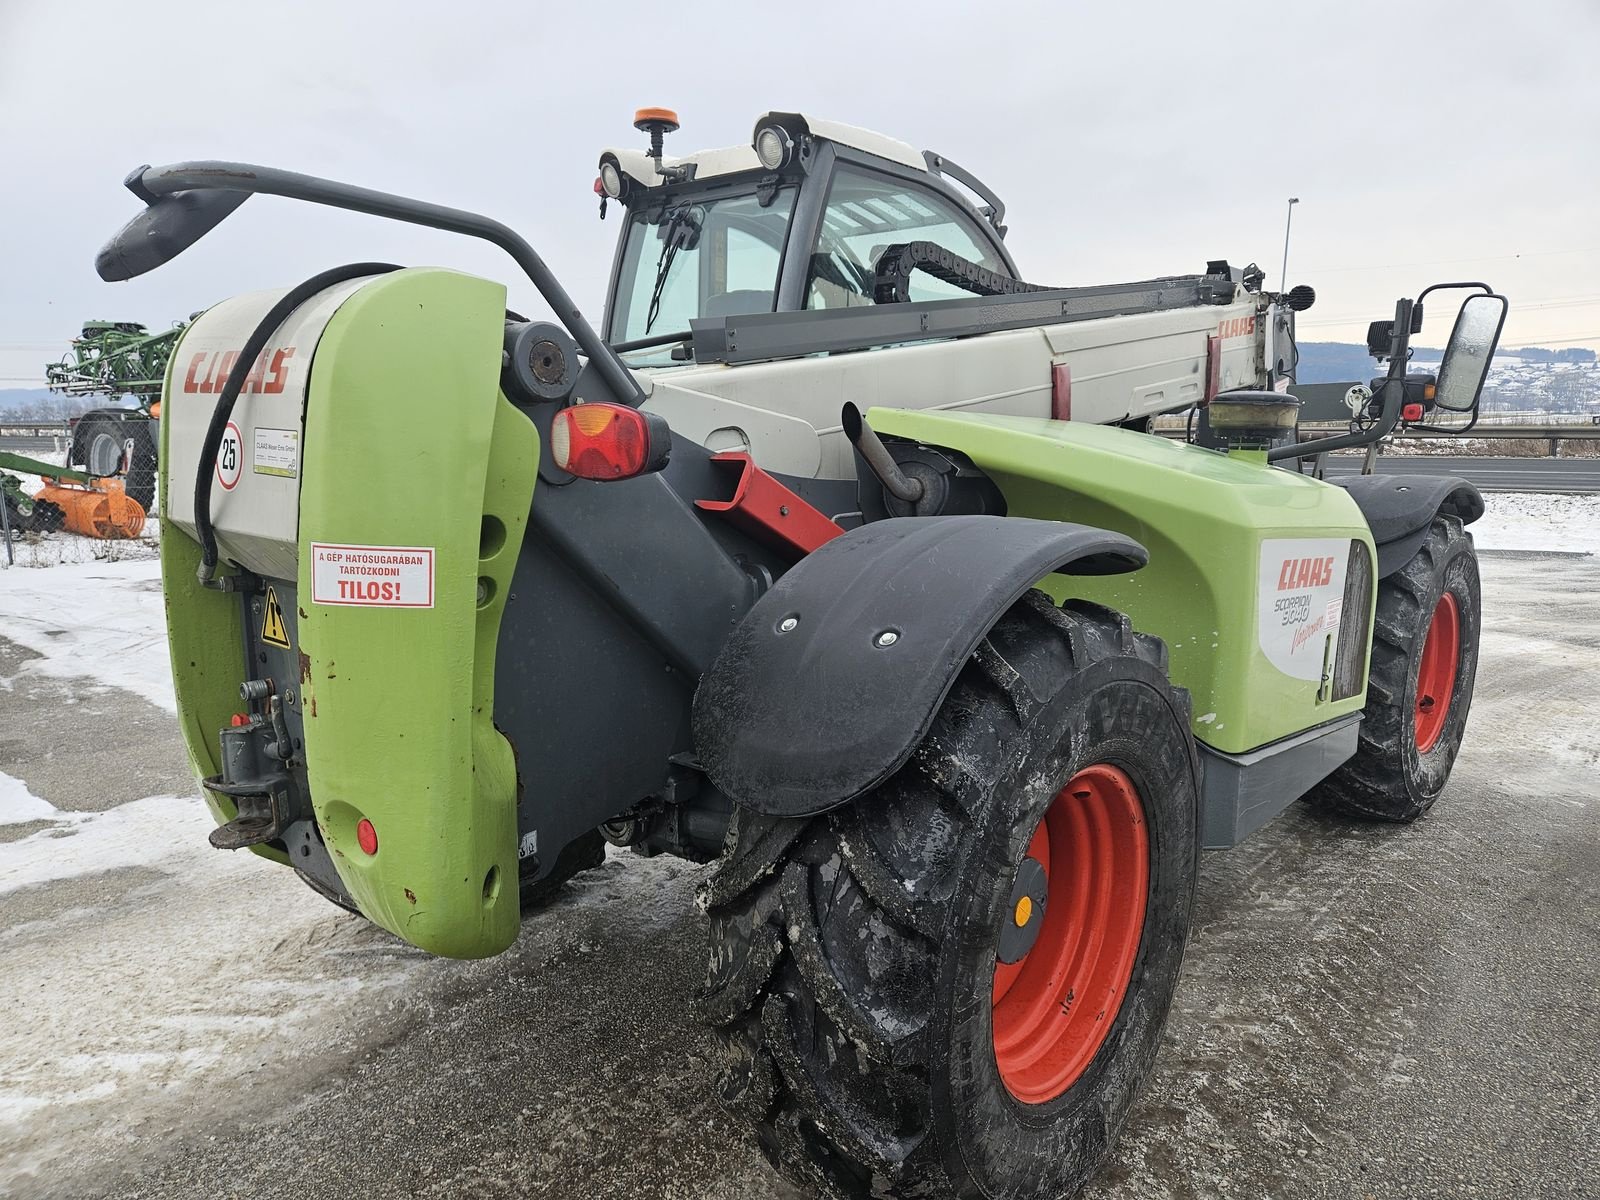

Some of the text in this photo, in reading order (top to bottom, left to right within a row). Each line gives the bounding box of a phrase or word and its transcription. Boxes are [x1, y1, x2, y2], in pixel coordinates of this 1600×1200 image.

[1218, 316, 1256, 339] CLAAS
[222, 438, 236, 470] 25
[319, 552, 423, 565] A GÉP HATÓSUGARÁBAN
[339, 565, 400, 576] TARTÓZKODNI
[1277, 557, 1334, 591] CLAAS
[338, 580, 401, 601] TILOS!
[1274, 594, 1312, 612] SCORPION
[1281, 606, 1310, 626] 9040
